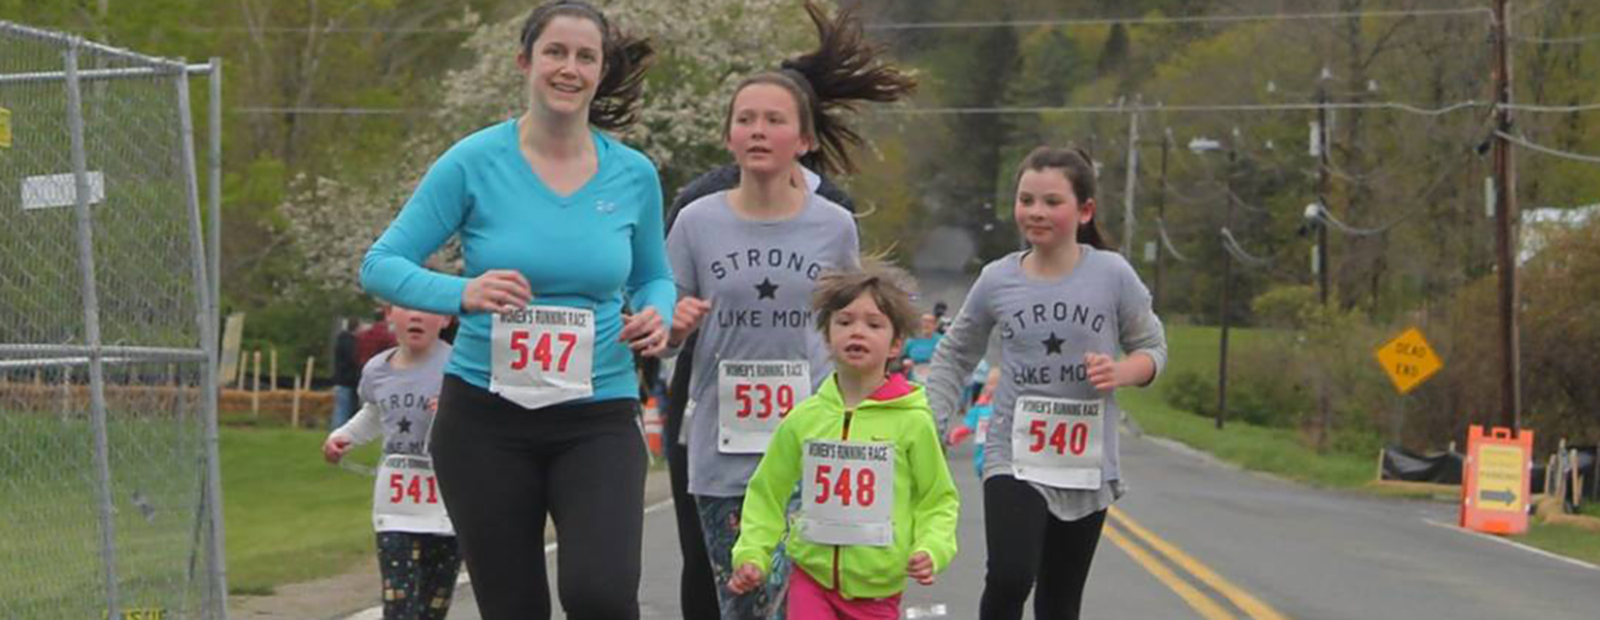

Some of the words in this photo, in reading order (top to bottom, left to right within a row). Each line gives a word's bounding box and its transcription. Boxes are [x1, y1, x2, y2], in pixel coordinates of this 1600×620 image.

[711, 248, 821, 280] STRONG
[569, 311, 587, 328] RACE
[717, 310, 762, 328] LIKE
[1002, 301, 1105, 339] STRONG
[510, 330, 578, 373] 547
[1395, 342, 1428, 359] DEAD
[1060, 363, 1088, 383] MO
[1395, 363, 1420, 378] END
[735, 383, 793, 419] 539
[1029, 419, 1088, 456] 540
[868, 445, 888, 462] RACE
[390, 473, 438, 504] 541
[814, 464, 876, 507] 548
